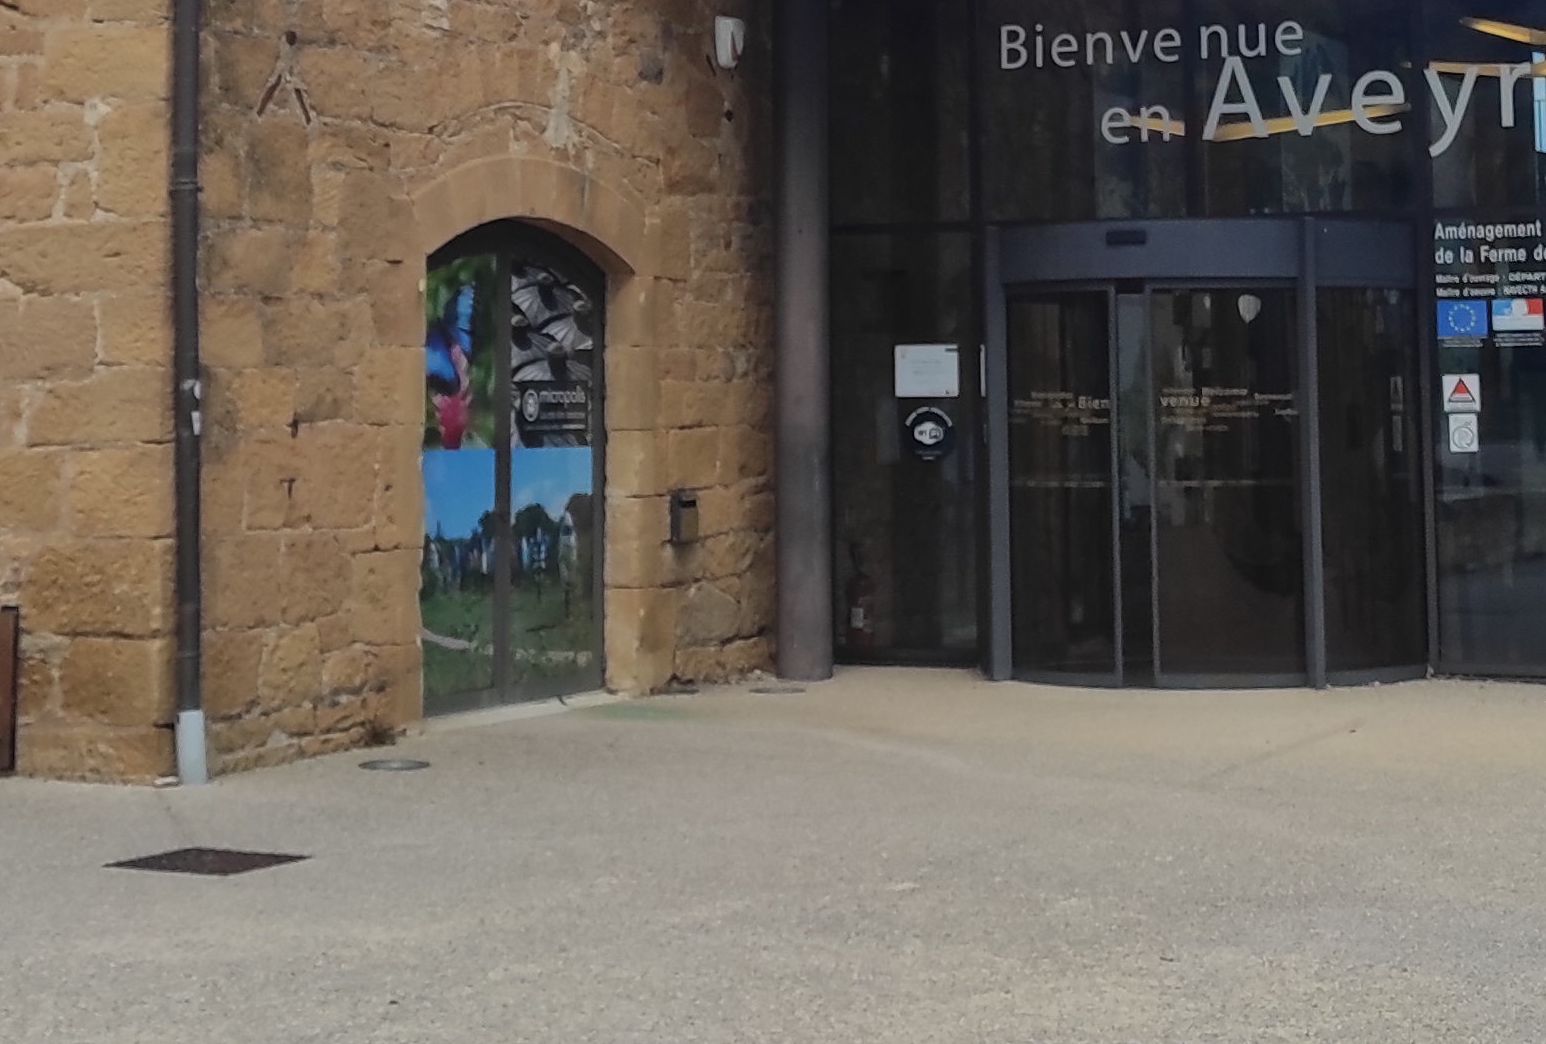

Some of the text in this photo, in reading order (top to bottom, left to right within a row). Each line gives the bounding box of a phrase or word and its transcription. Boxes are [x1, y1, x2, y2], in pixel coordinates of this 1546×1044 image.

[1100, 103, 1172, 145] en
[1434, 219, 1542, 243] Aménagement
[1434, 246, 1454, 265] de
[1459, 245, 1474, 264] la
[1479, 244, 1527, 263] Ferme
